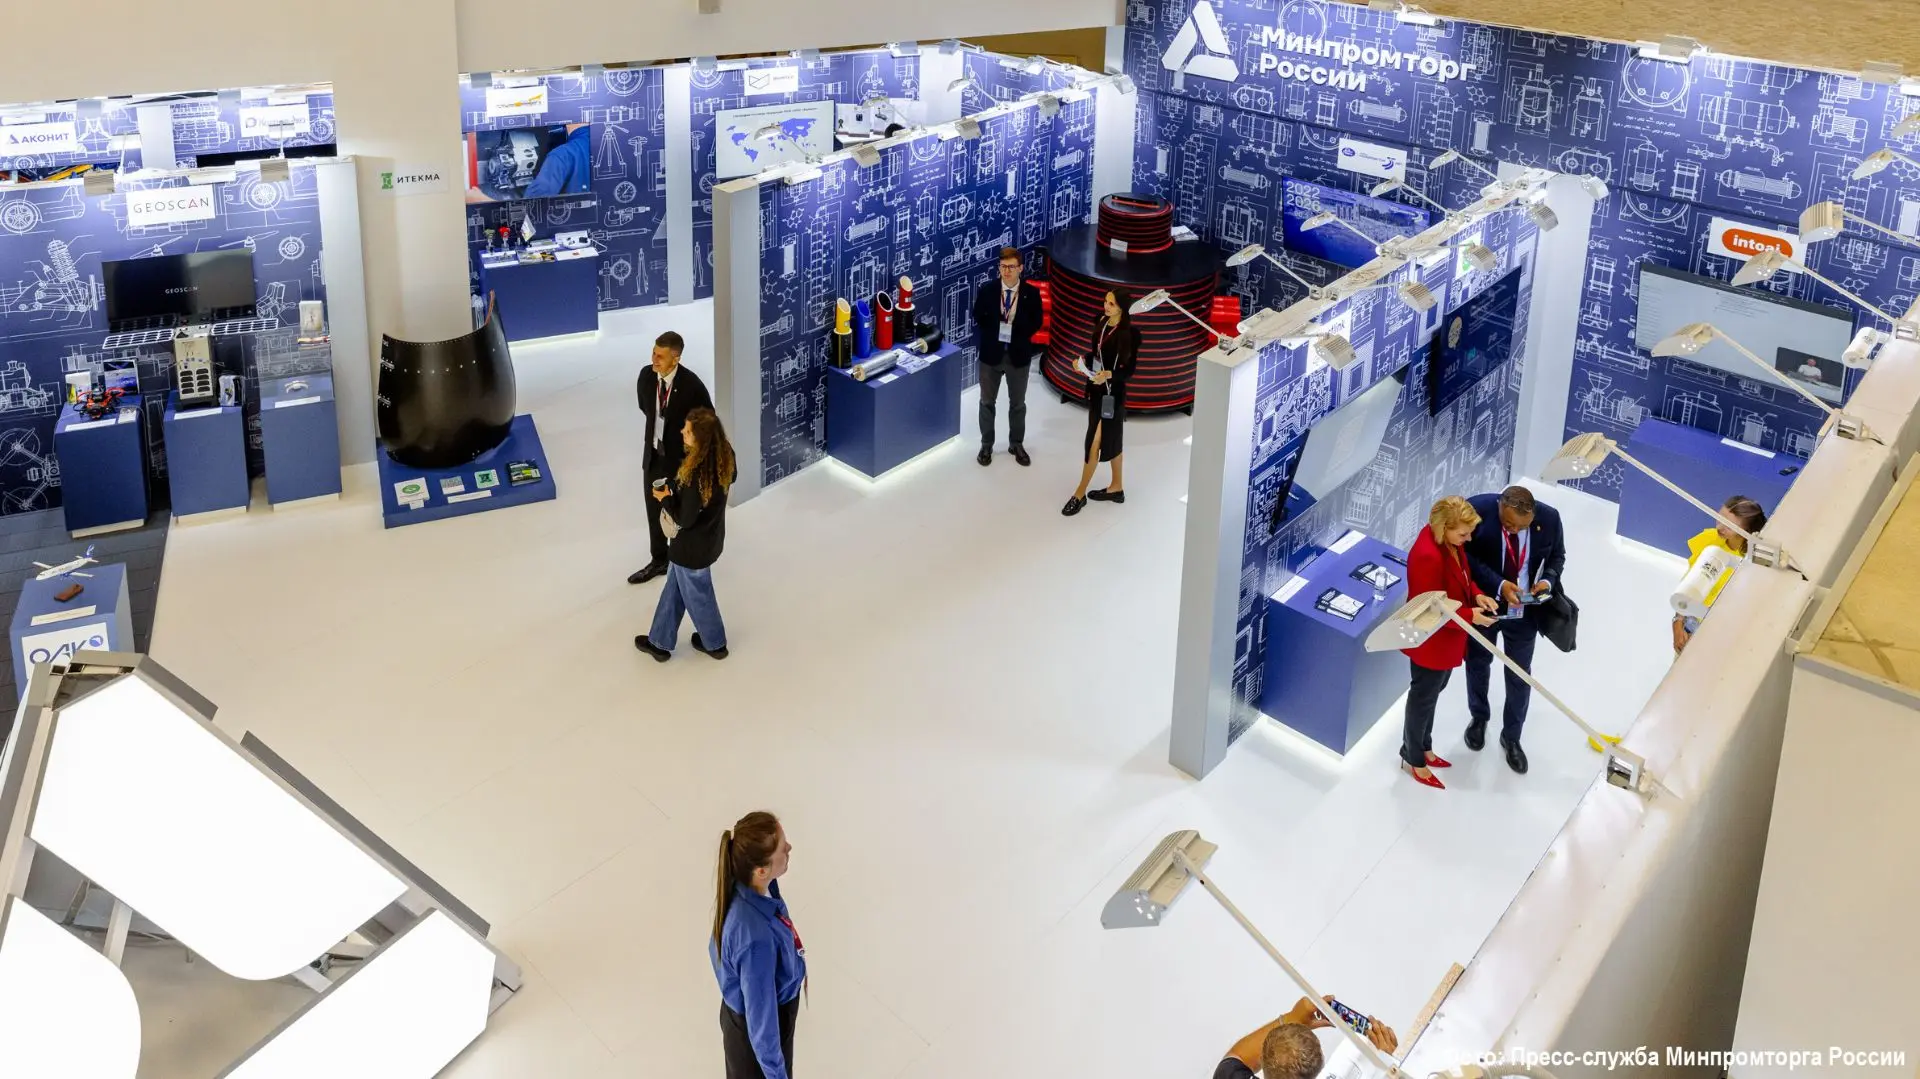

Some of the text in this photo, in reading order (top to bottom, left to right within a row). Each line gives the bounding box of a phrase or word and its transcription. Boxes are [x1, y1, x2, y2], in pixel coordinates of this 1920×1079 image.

[1261, 26, 1477, 82] Минпромторг
[1260, 53, 1367, 92] России
[22, 133, 69, 143] АКОНИТ
[397, 173, 440, 183] ИТЕКМА
[1286, 181, 1320, 199] 2022
[133, 197, 209, 213] GEOSCAN
[1286, 194, 1321, 212] 2026
[165, 286, 198, 294] GEOSCAN
